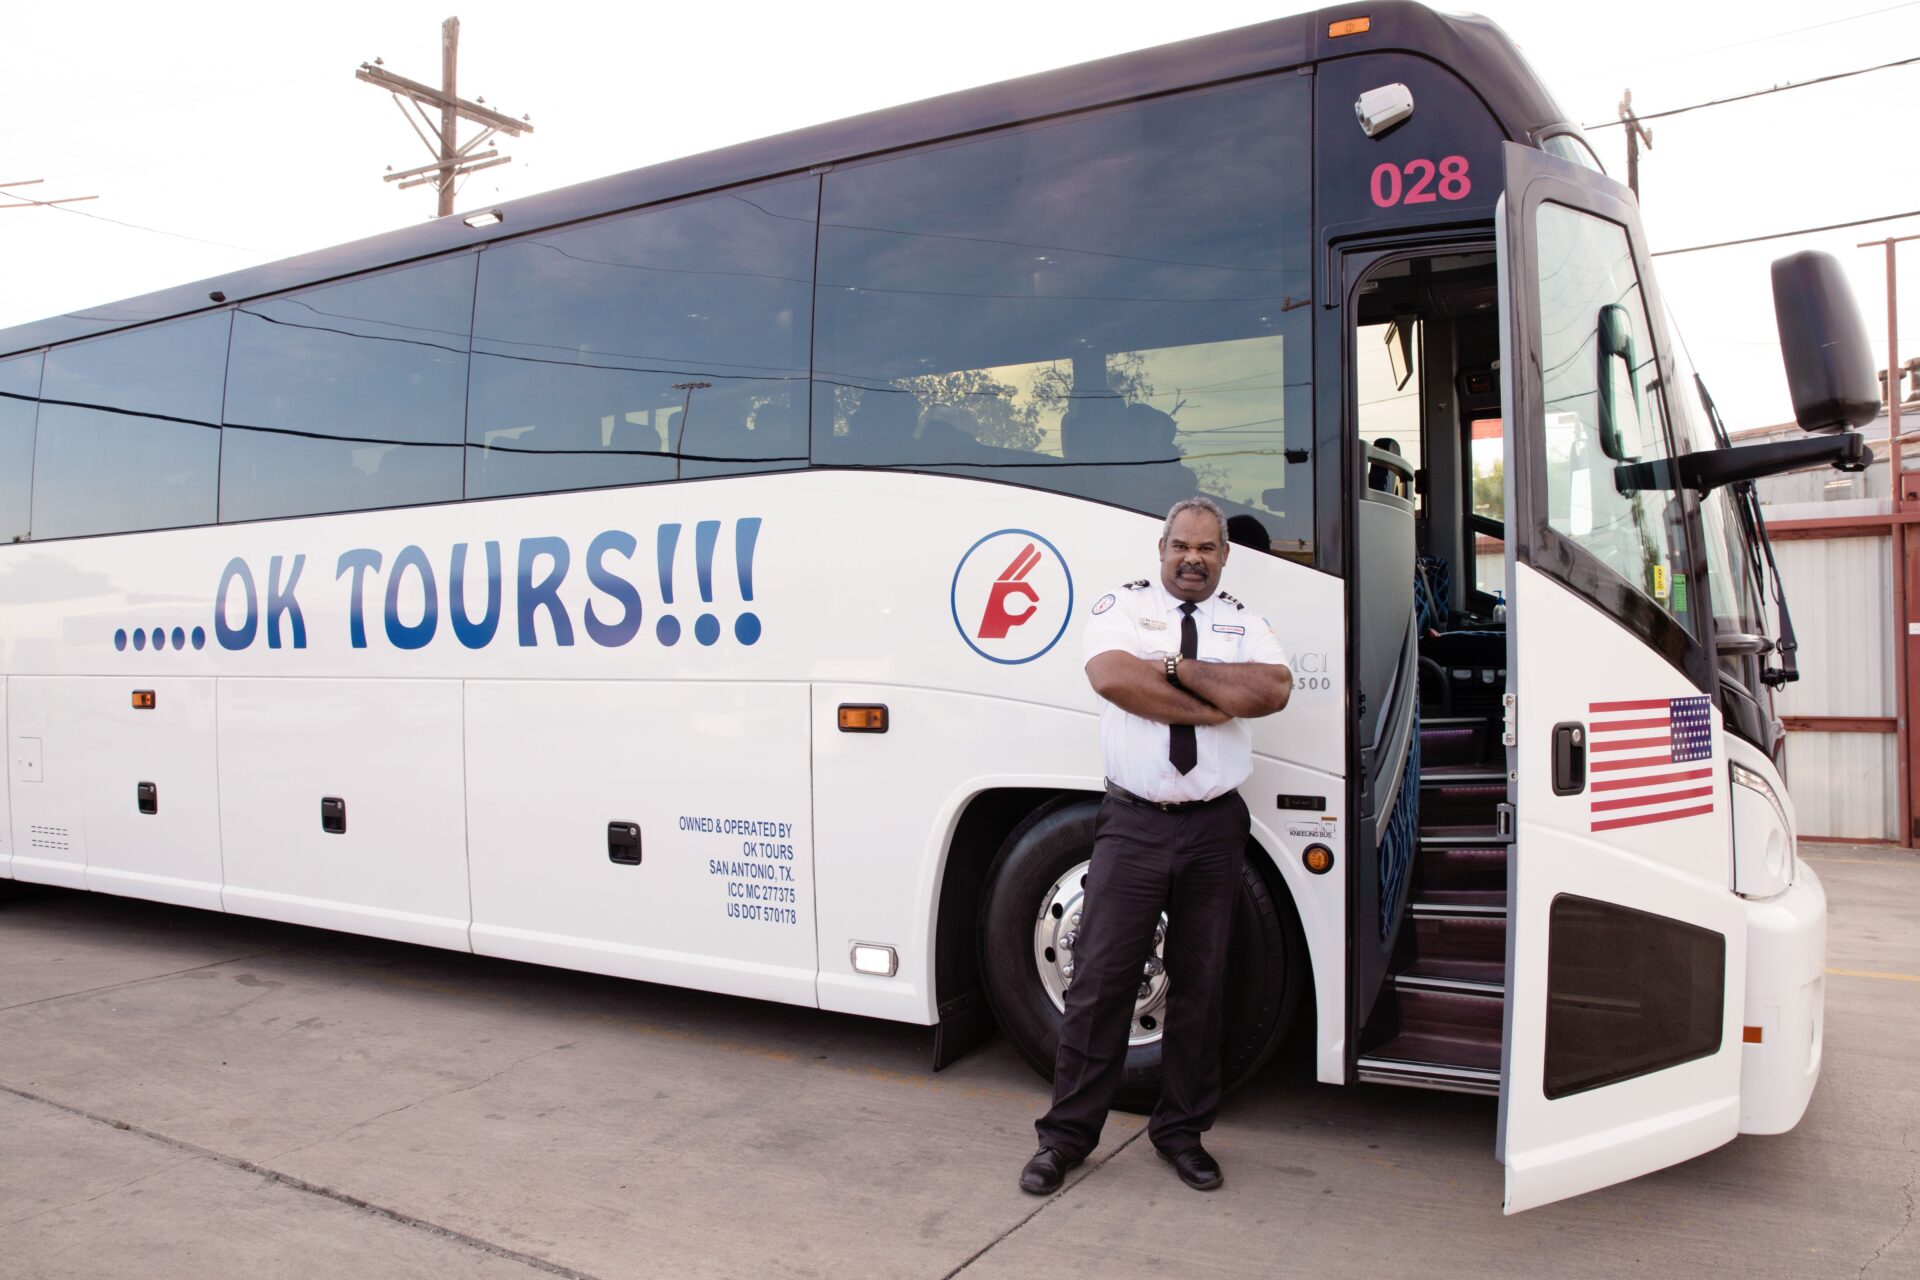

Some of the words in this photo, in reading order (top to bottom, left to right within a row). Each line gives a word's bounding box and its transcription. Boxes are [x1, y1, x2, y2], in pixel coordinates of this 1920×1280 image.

[1370, 155, 1472, 208] 028
[335, 516, 762, 653] TOURS!!!
[1291, 677, 1331, 690] 500
[679, 815, 714, 833] OWNED
[715, 818, 723, 834] &
[723, 819, 777, 838] OPERATED
[778, 822, 793, 839] BY
[1289, 830, 1319, 838] KNEELING
[1319, 831, 1332, 839] BUS
[743, 841, 758, 858] OK
[759, 842, 794, 861] TOURS
[709, 859, 729, 876] SAN
[731, 861, 778, 883] ANTONIO,
[778, 865, 795, 882] TX.
[727, 882, 744, 898] ICC
[746, 883, 761, 900] MC
[762, 885, 796, 904] 277375
[727, 902, 740, 919] US
[742, 903, 761, 921] DOT
[763, 906, 797, 925] 570178
